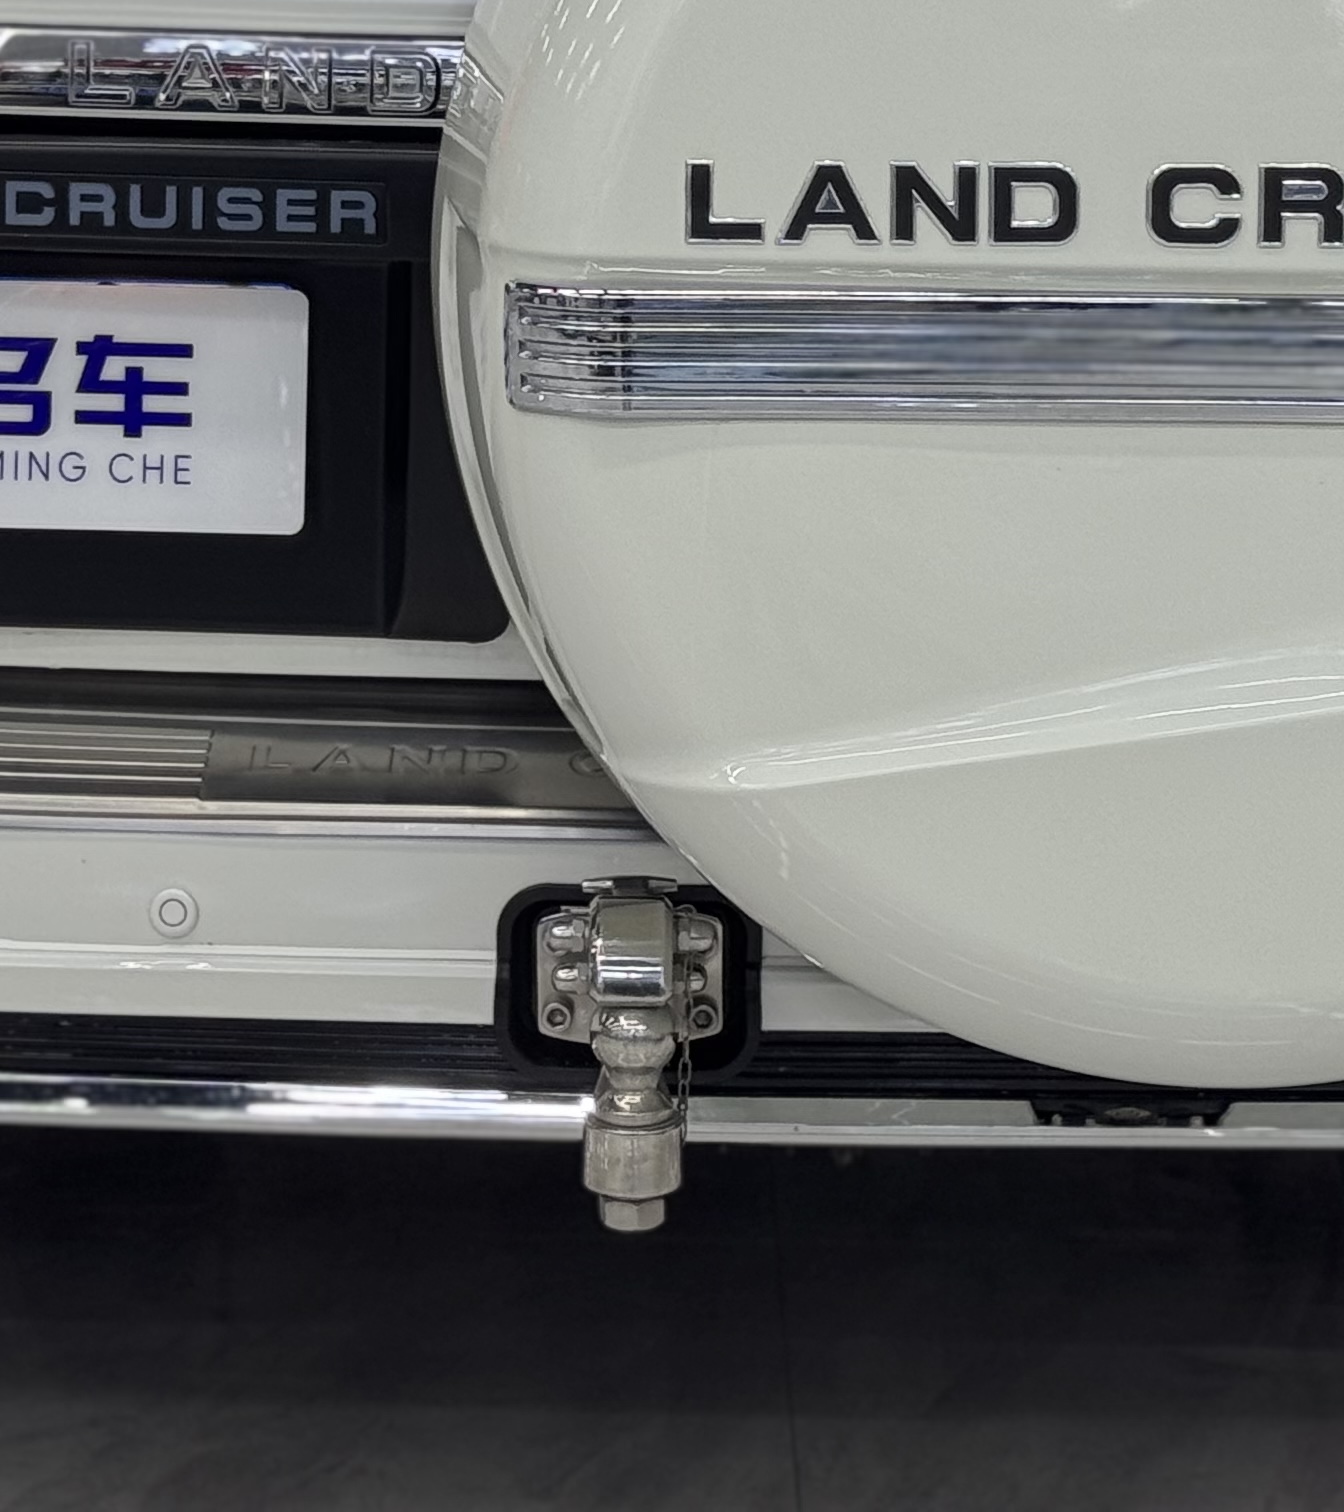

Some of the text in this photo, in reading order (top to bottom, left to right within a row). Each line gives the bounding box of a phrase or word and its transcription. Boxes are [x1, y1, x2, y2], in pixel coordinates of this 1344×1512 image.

[67, 39, 442, 116] LAND
[4, 181, 380, 236] CRUISER
[684, 159, 1081, 247] LAND
[107, 453, 193, 486] CHE
[249, 742, 520, 776] LAND
